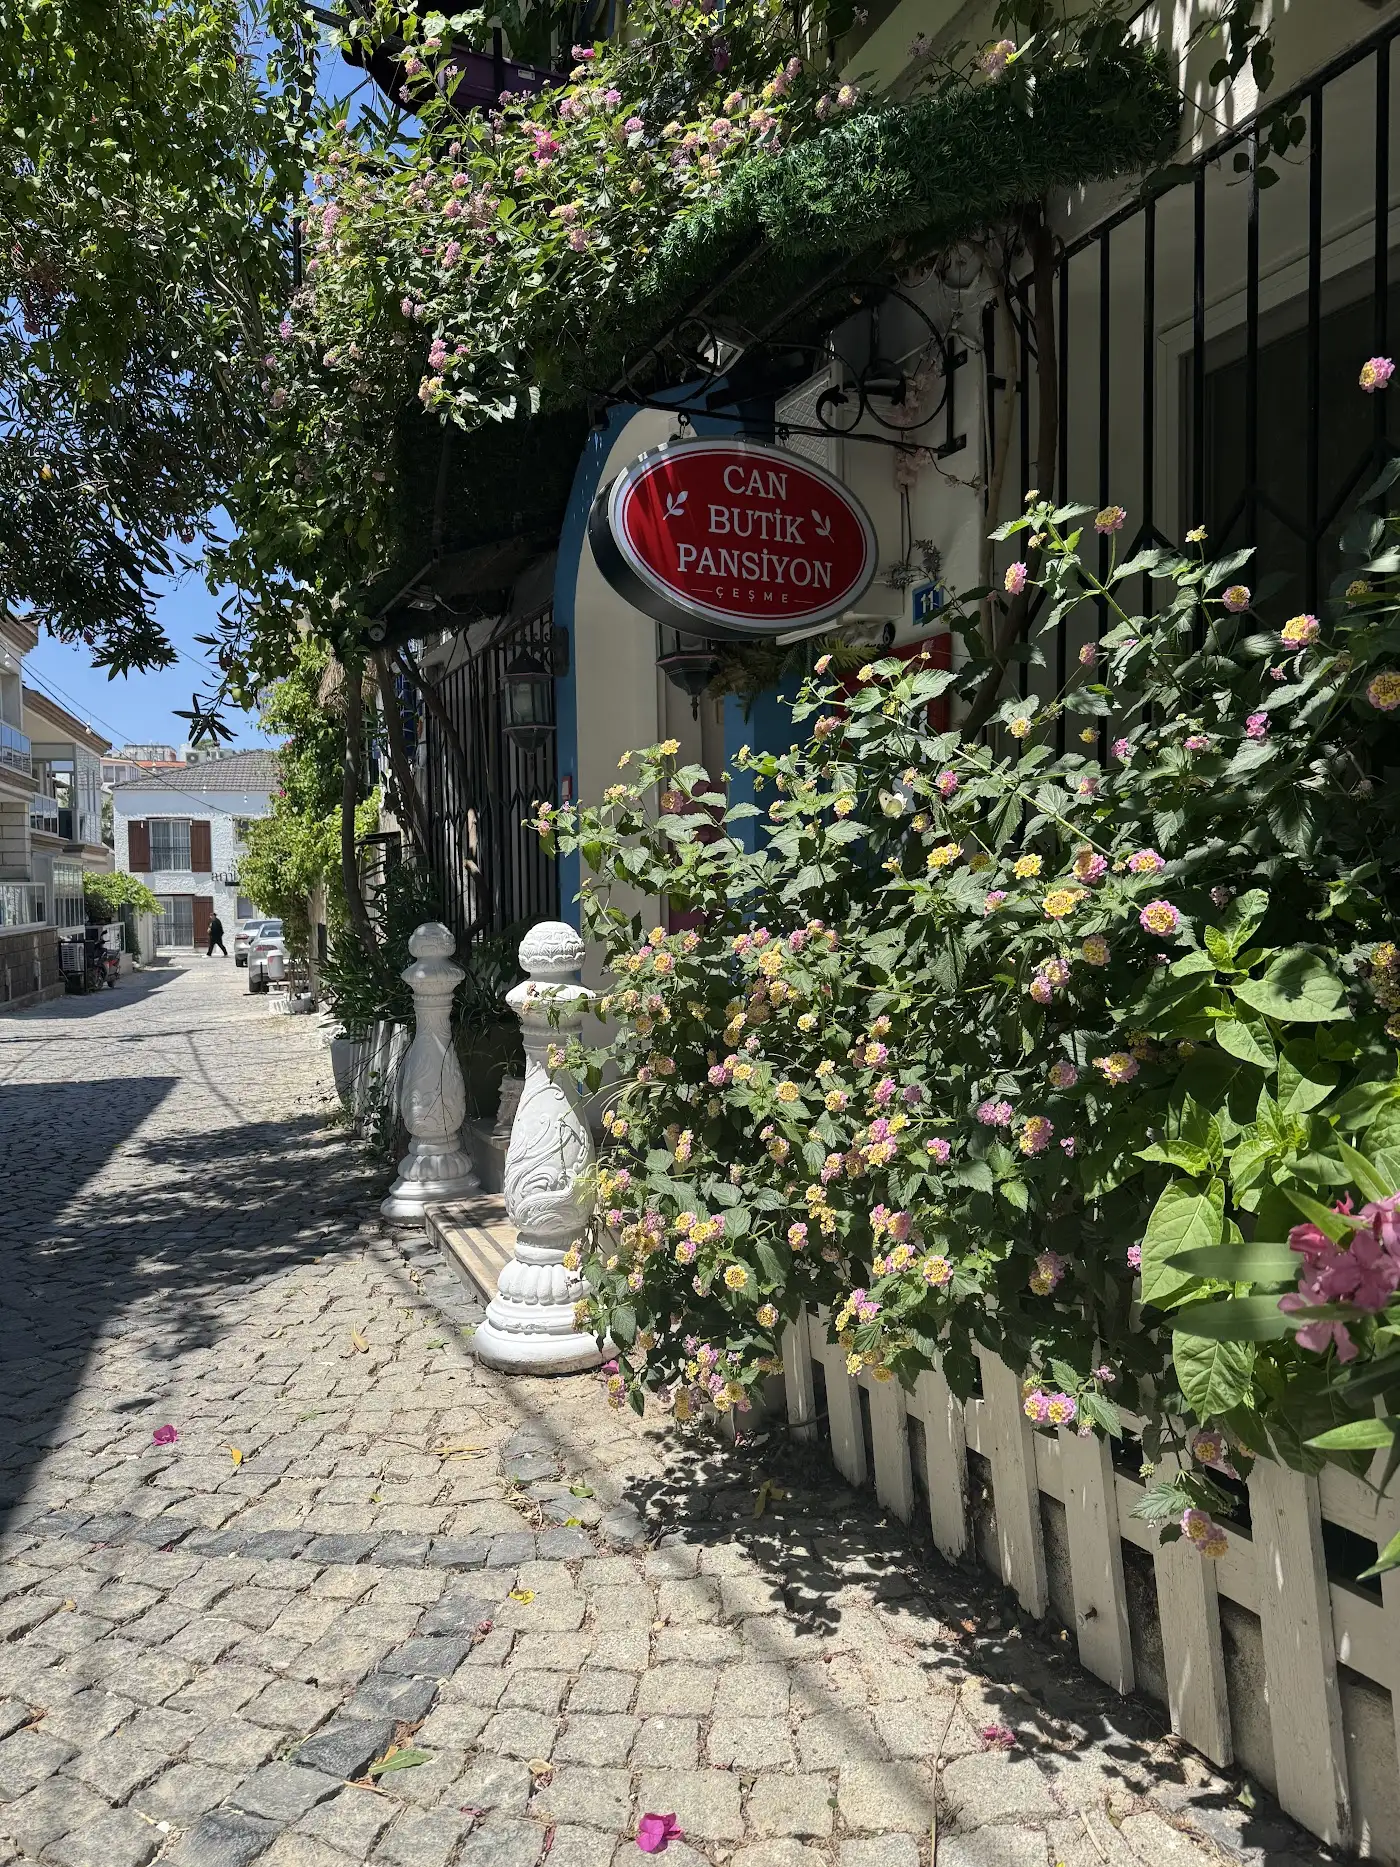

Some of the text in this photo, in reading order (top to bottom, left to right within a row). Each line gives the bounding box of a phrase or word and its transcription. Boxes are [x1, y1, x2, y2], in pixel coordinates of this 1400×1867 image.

[723, 465, 788, 501] CAN
[708, 504, 804, 544] BUTİK
[677, 543, 832, 589] PANSİYON
[715, 586, 789, 604] ÇEŞME
